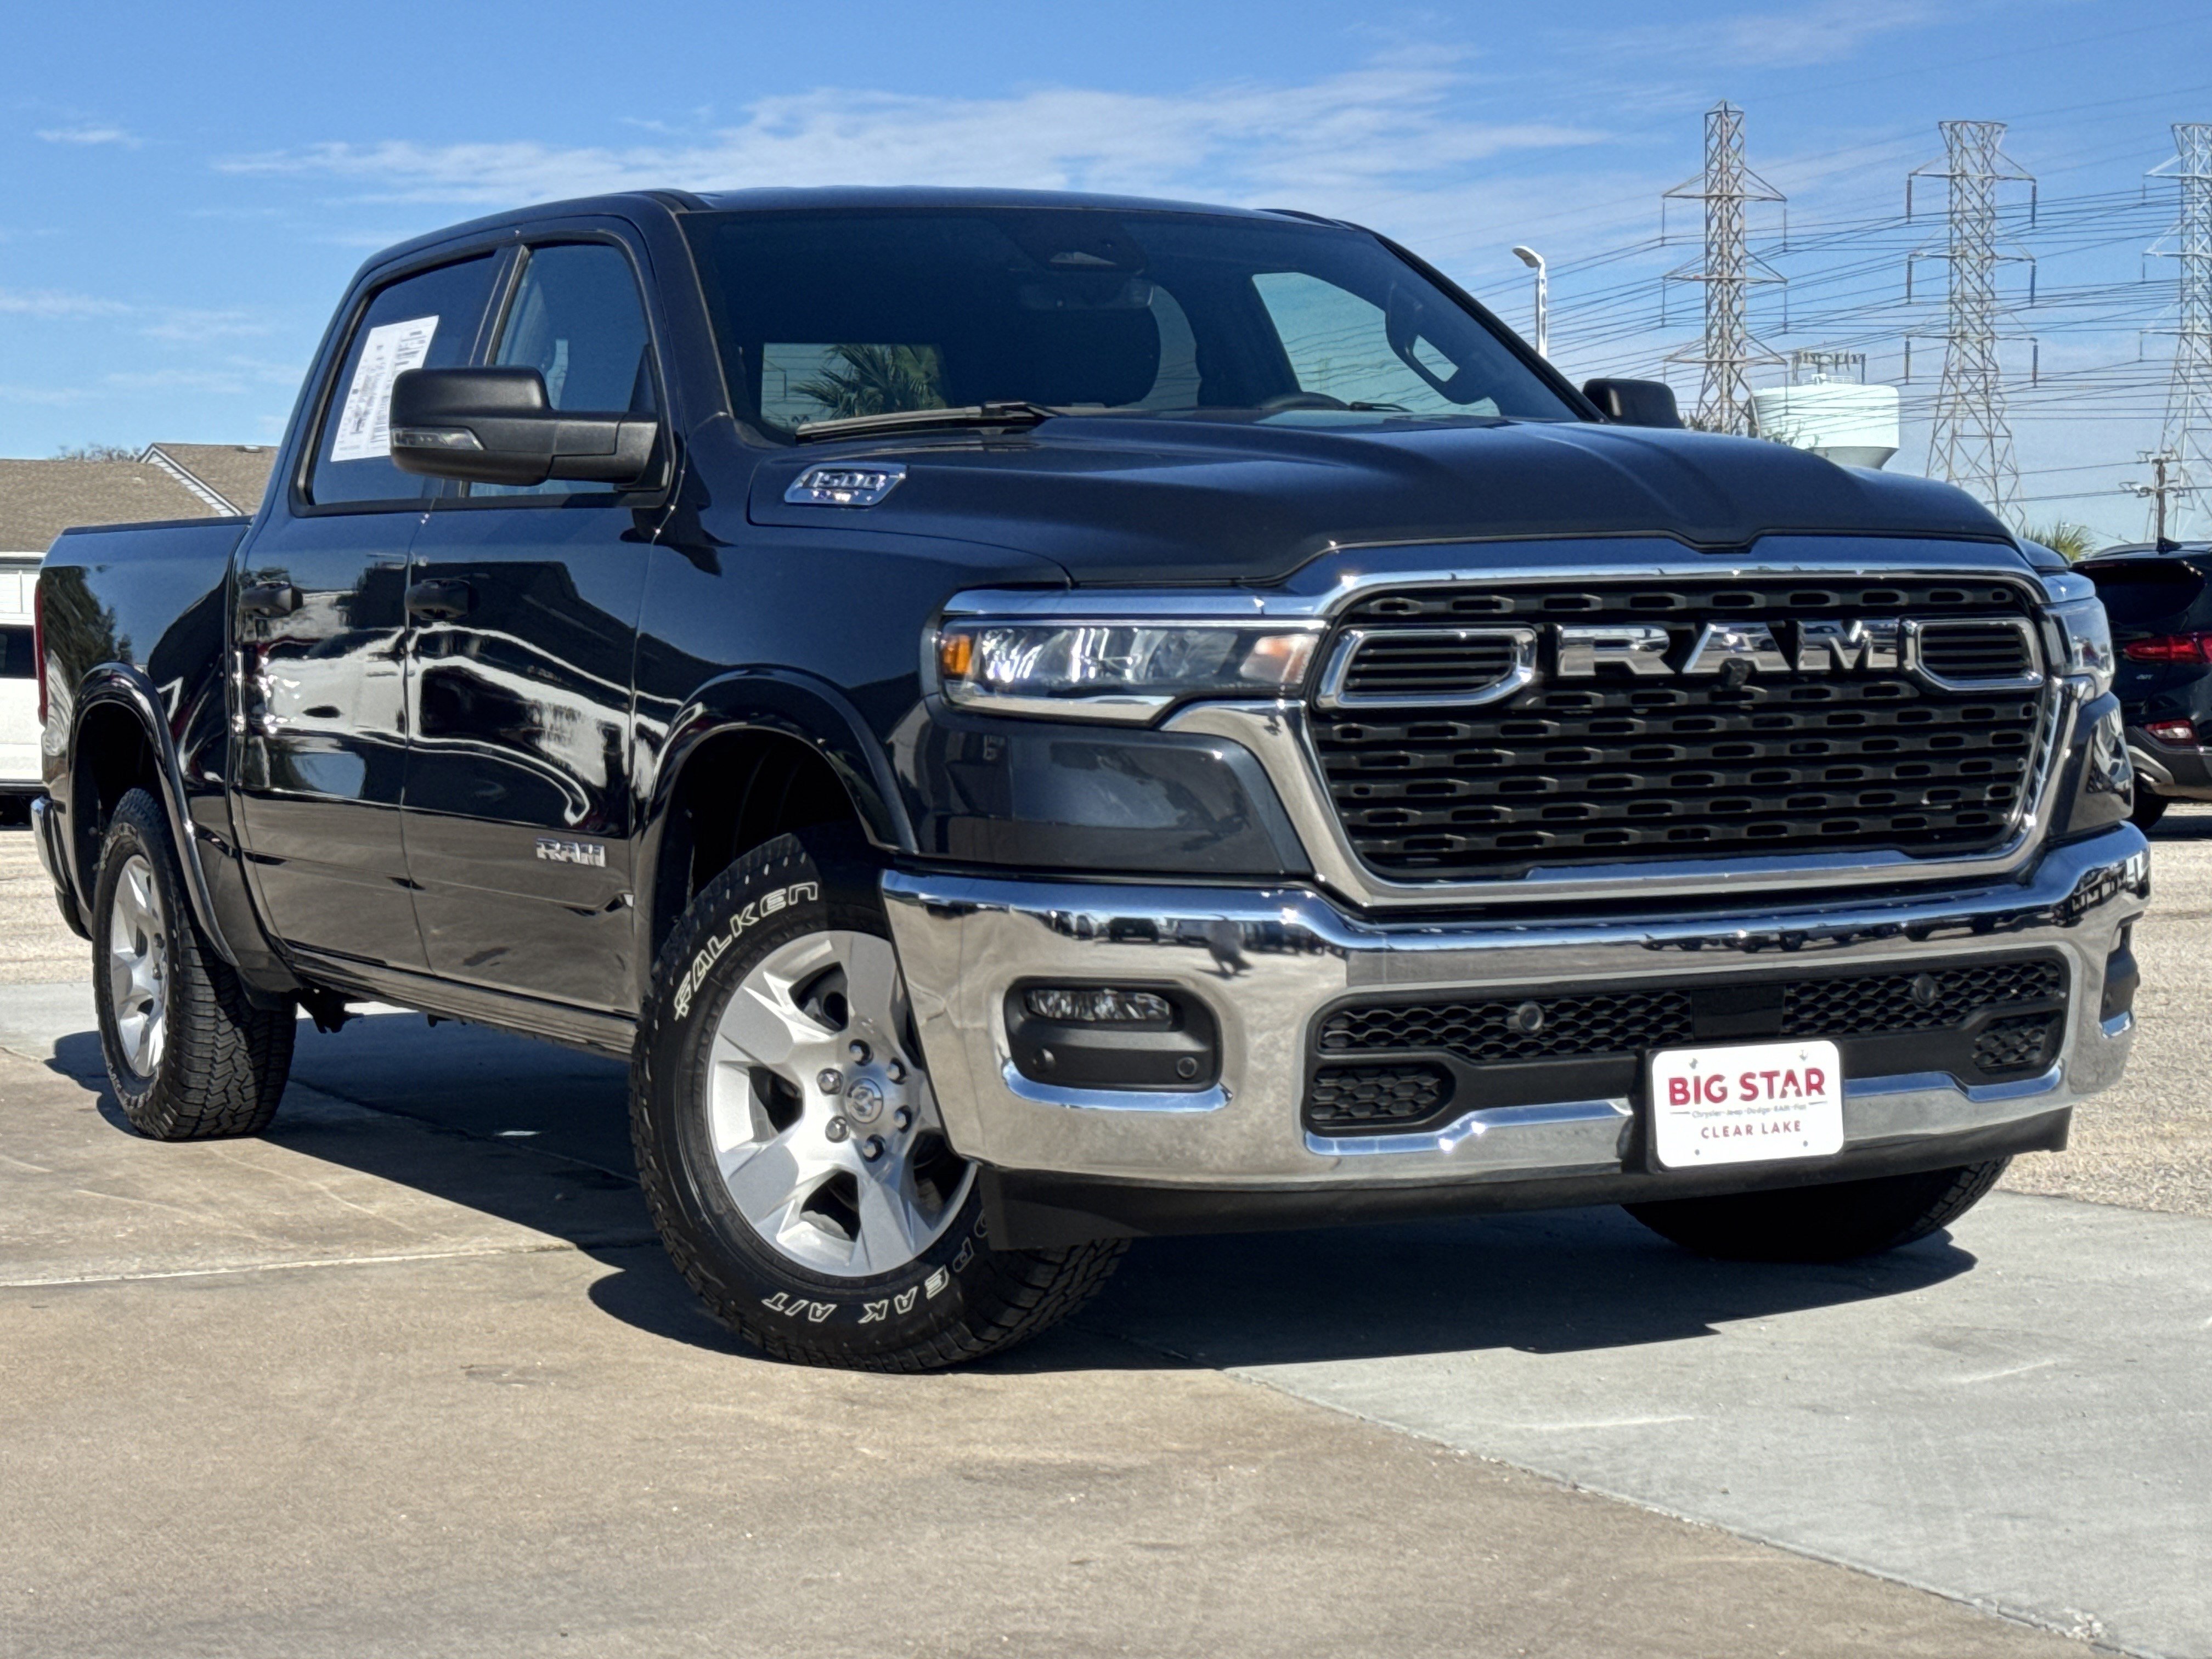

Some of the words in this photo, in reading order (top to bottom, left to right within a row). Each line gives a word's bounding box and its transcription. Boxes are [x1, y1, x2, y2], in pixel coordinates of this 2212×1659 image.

[1556, 619, 1899, 675] RAM
[535, 837, 606, 867] RAM
[673, 881, 818, 1021] FALKEN
[1668, 1074, 1728, 1107] BIG
[1739, 1067, 1826, 1102] STAR
[1701, 1121, 1754, 1139] CLEAR
[1761, 1120, 1802, 1135] LAKE
[761, 1291, 838, 1323] A/T
